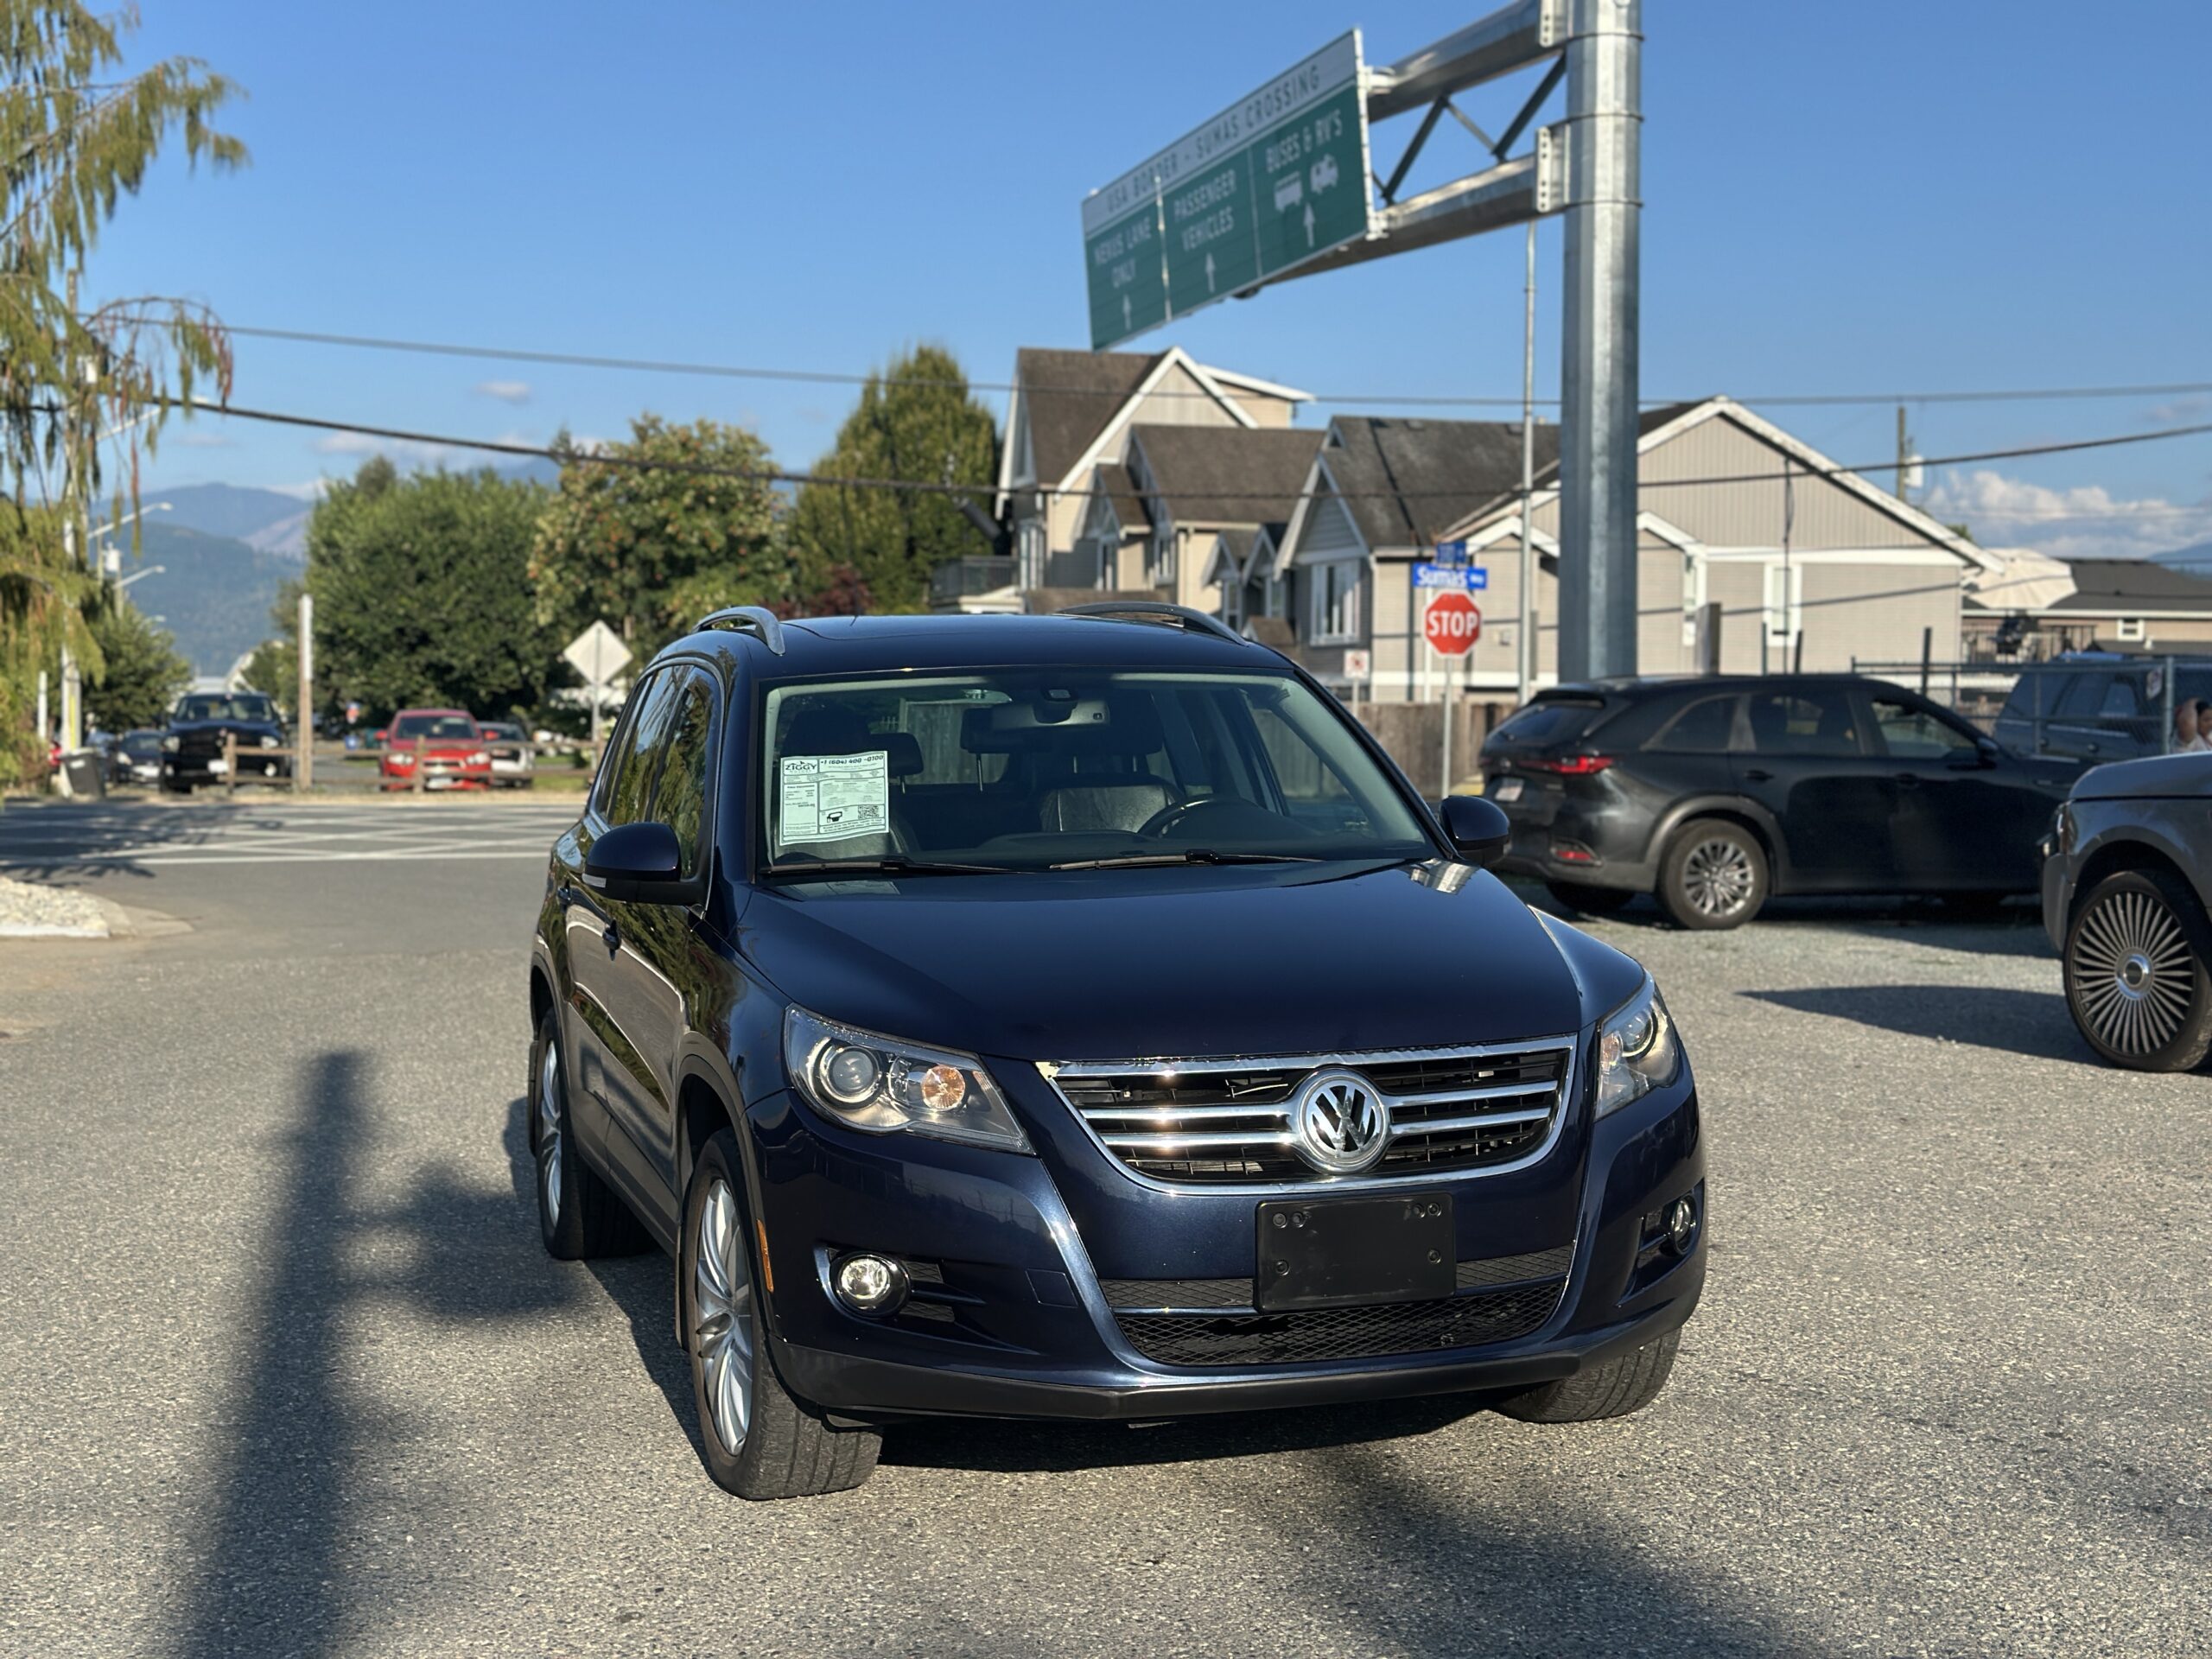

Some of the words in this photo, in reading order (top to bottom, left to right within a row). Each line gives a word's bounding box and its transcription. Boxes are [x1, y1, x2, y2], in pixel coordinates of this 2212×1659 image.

[1107, 185, 1128, 213] USA
[1133, 151, 1179, 199] BORDER
[1196, 114, 1241, 160] SUMAS
[1245, 64, 1321, 130] CROSSING
[1266, 131, 1300, 174] BUSES
[1302, 125, 1313, 153] &
[1173, 168, 1237, 223] PASSENGER
[1126, 216, 1152, 249] LANE
[1181, 206, 1235, 252] VEHICLES
[1417, 564, 1468, 588] Sumas
[1428, 611, 1478, 637] STOP
[1305, 1080, 1382, 1156] VW
